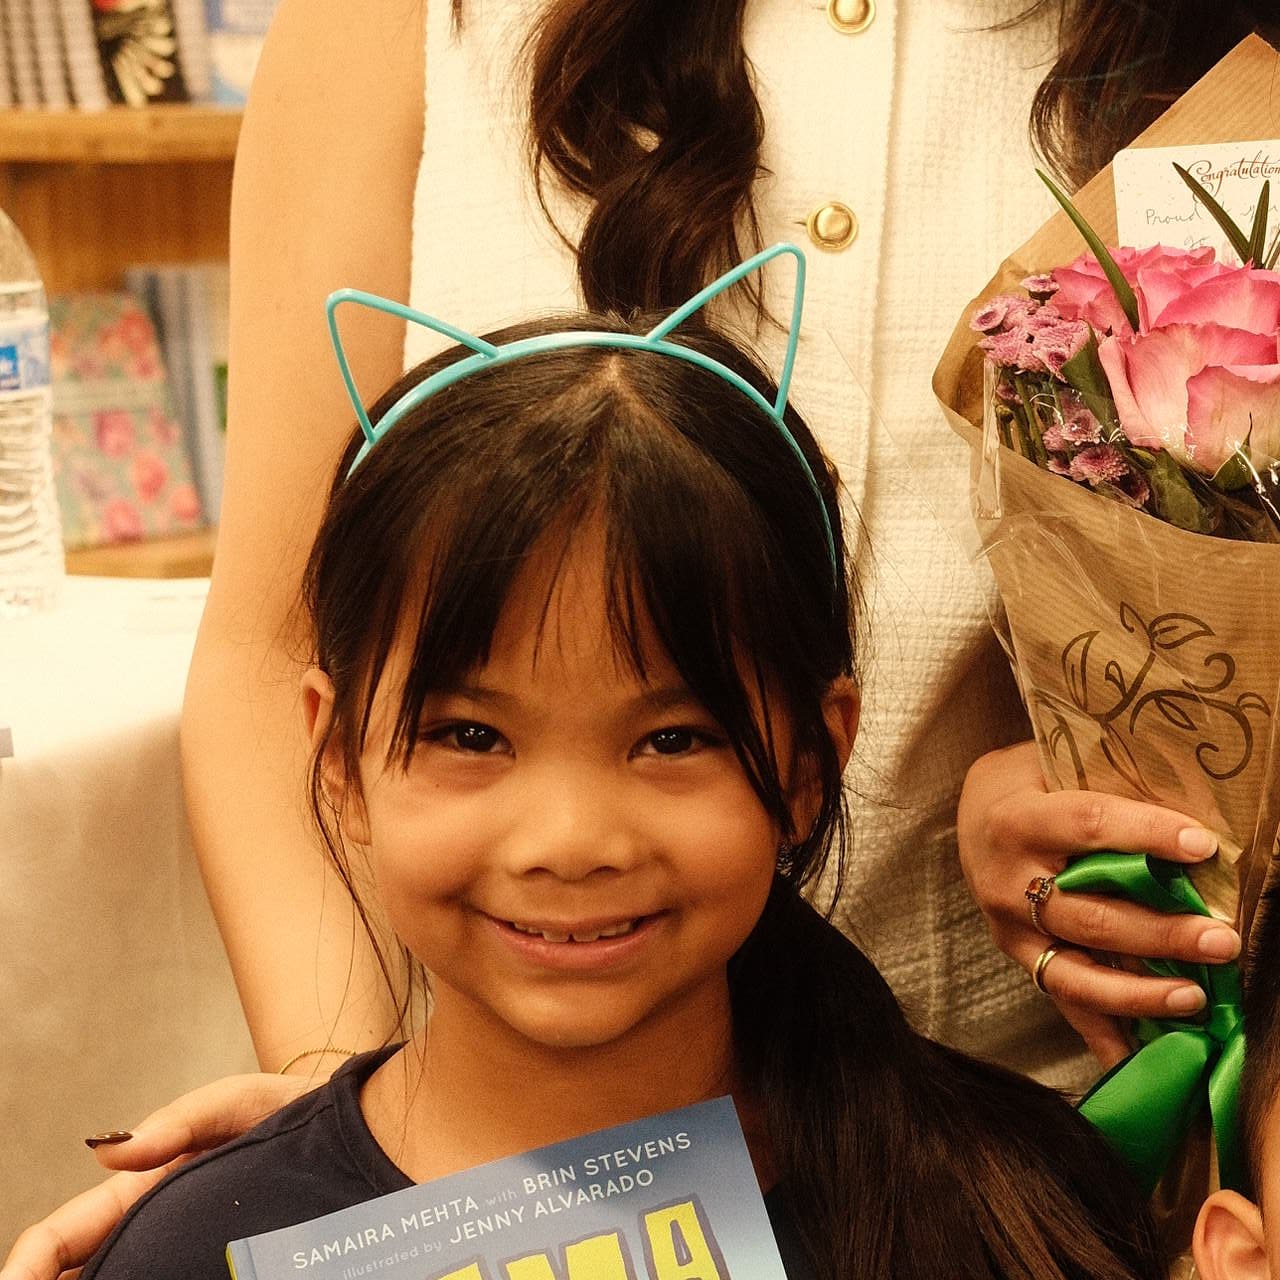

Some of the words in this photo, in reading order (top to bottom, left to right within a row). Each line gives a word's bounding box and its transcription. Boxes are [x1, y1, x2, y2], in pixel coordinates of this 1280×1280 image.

[293, 1223, 395, 1269] SAMAIRA
[401, 1196, 479, 1234] MEHTA
[485, 1188, 517, 1207] with
[523, 1165, 577, 1195] BRIN
[584, 1132, 692, 1176] STEVENS
[342, 1245, 420, 1280] illustrated
[423, 1239, 443, 1252] by
[450, 1206, 525, 1244] JENNY
[535, 1169, 654, 1219] ALVARADO
